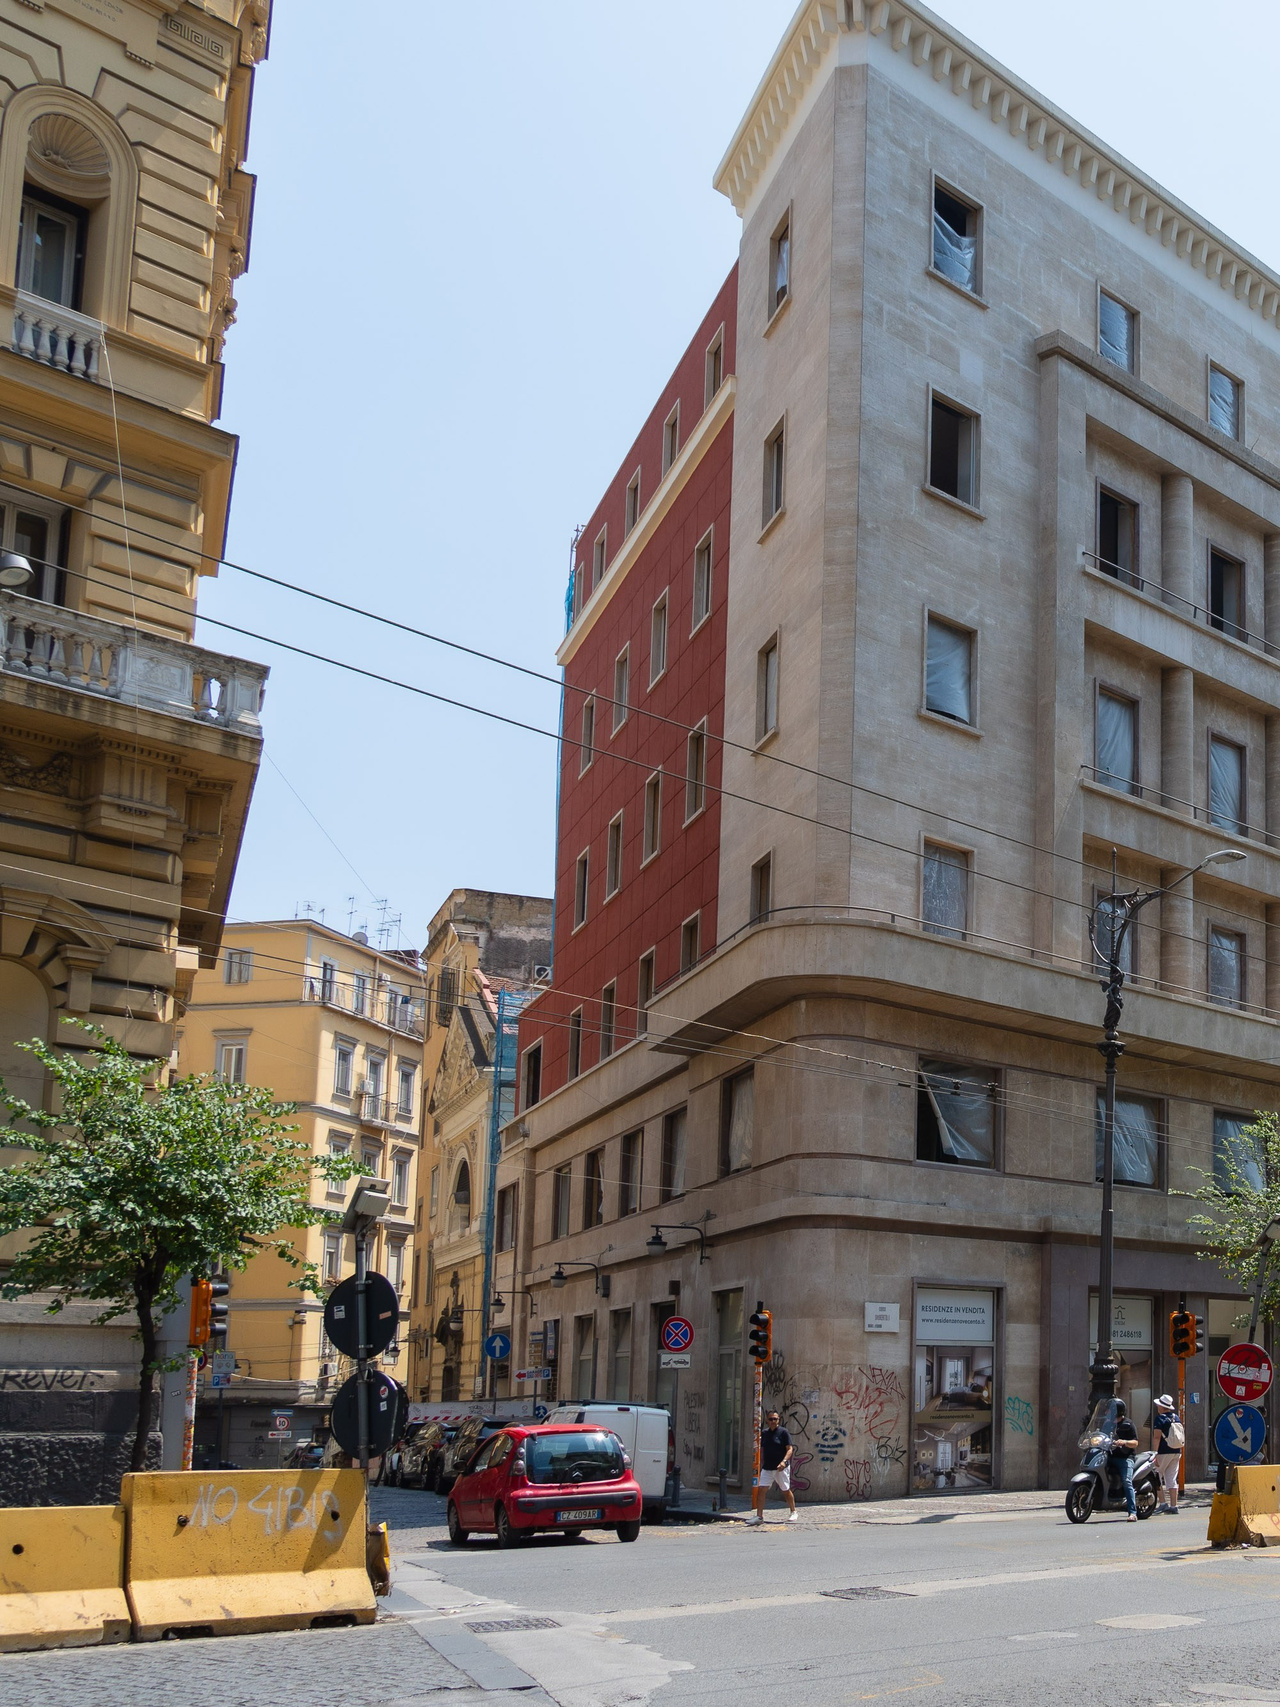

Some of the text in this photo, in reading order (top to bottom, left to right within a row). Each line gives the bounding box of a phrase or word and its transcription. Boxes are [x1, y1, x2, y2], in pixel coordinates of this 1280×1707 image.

[921, 1305, 953, 1313] RESIDENZE
[962, 1306, 986, 1314] VENDITA
[188, 1483, 238, 1528] NO
